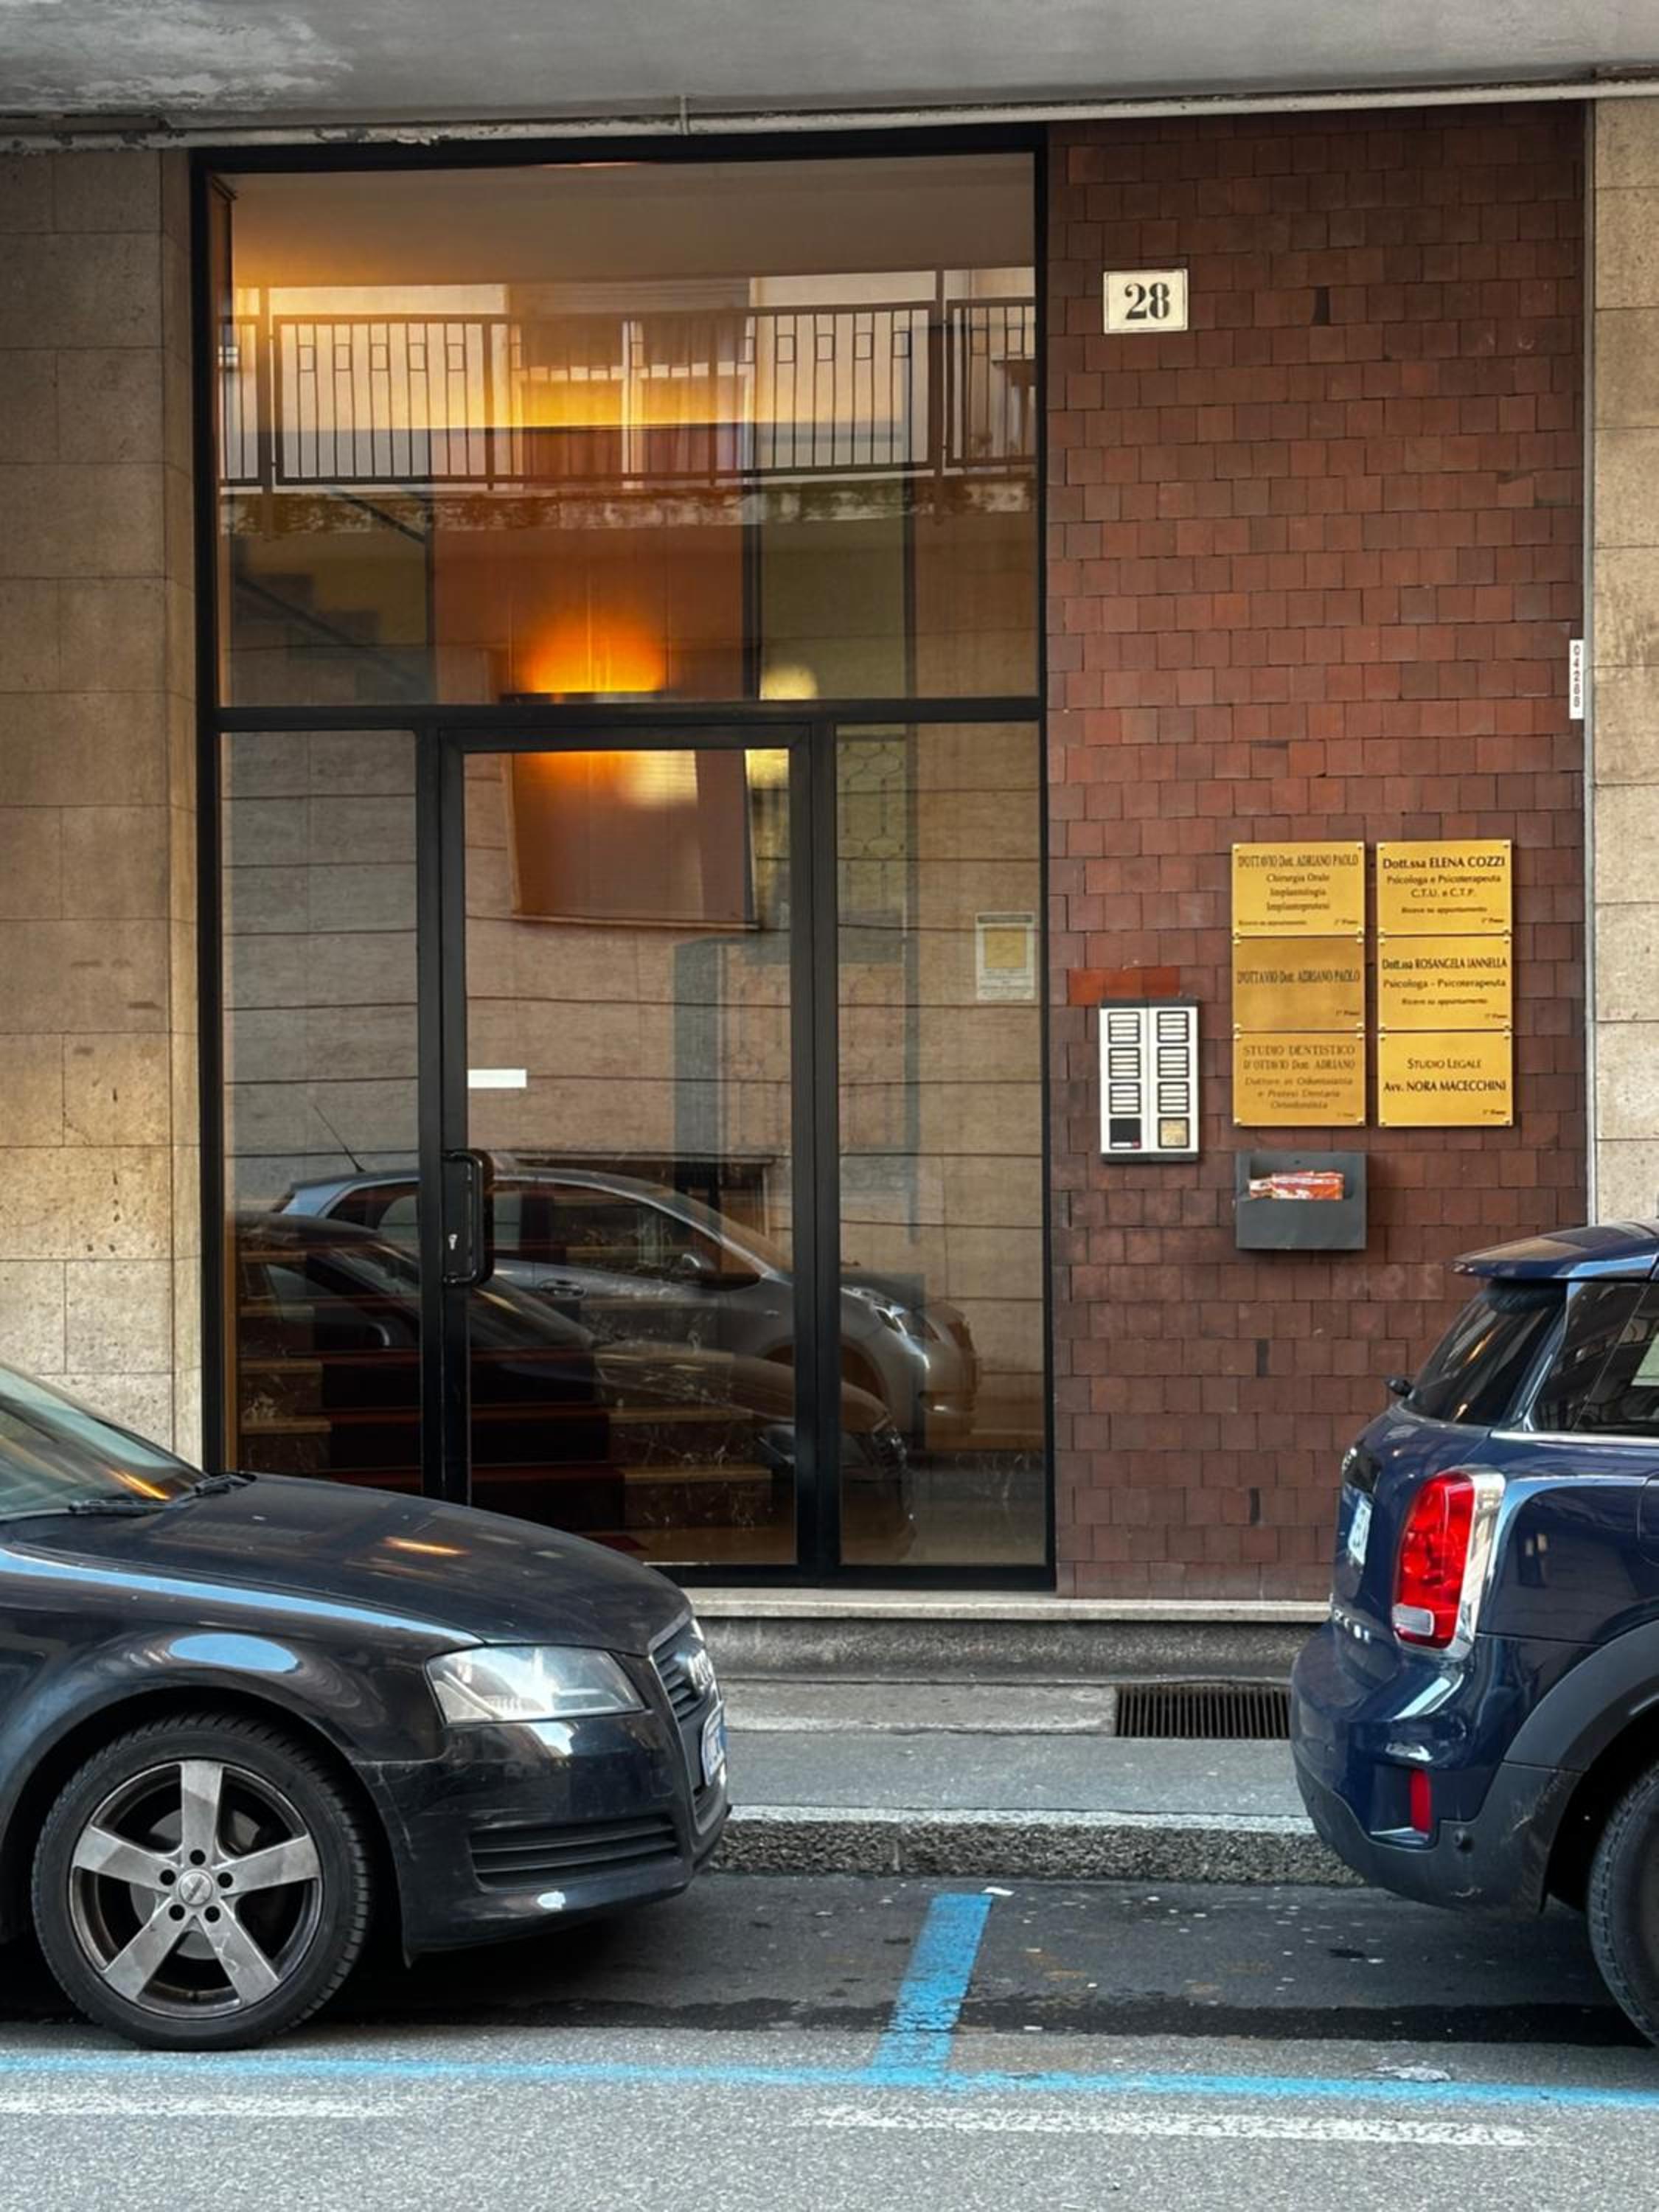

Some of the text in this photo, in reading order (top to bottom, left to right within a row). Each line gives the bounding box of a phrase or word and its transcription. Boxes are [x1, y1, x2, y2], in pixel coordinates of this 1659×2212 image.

[1124, 282, 1170, 320] 28
[1297, 855, 1332, 867] ADRIANO
[1333, 854, 1359, 866] PAOLO
[1383, 855, 1505, 869] Dott.ssa ELENA COZZI
[1266, 873, 1330, 883] Chirurgia Orale
[1387, 875, 1428, 886] Psicologa
[1438, 874, 1501, 885] Psicoterapeuta
[1411, 888, 1440, 897] C.T.U.
[1450, 888, 1476, 897] C.T.P.
[1382, 957, 1507, 970] Dott.ssa ROSANGELA IANNELLA
[1298, 970, 1333, 982] ADRIANO
[1335, 969, 1360, 982] PAOLO
[1383, 979, 1428, 990] Psicologa
[1438, 978, 1506, 989] Psicoterapeuta
[1243, 1045, 1355, 1057] STUDIO DENTISTICO
[1315, 1060, 1355, 1070] ADRIANO
[1407, 1058, 1482, 1069] STUDIO LEGALE
[1383, 1080, 1506, 1092] Avv. NORA MACECCHINI
